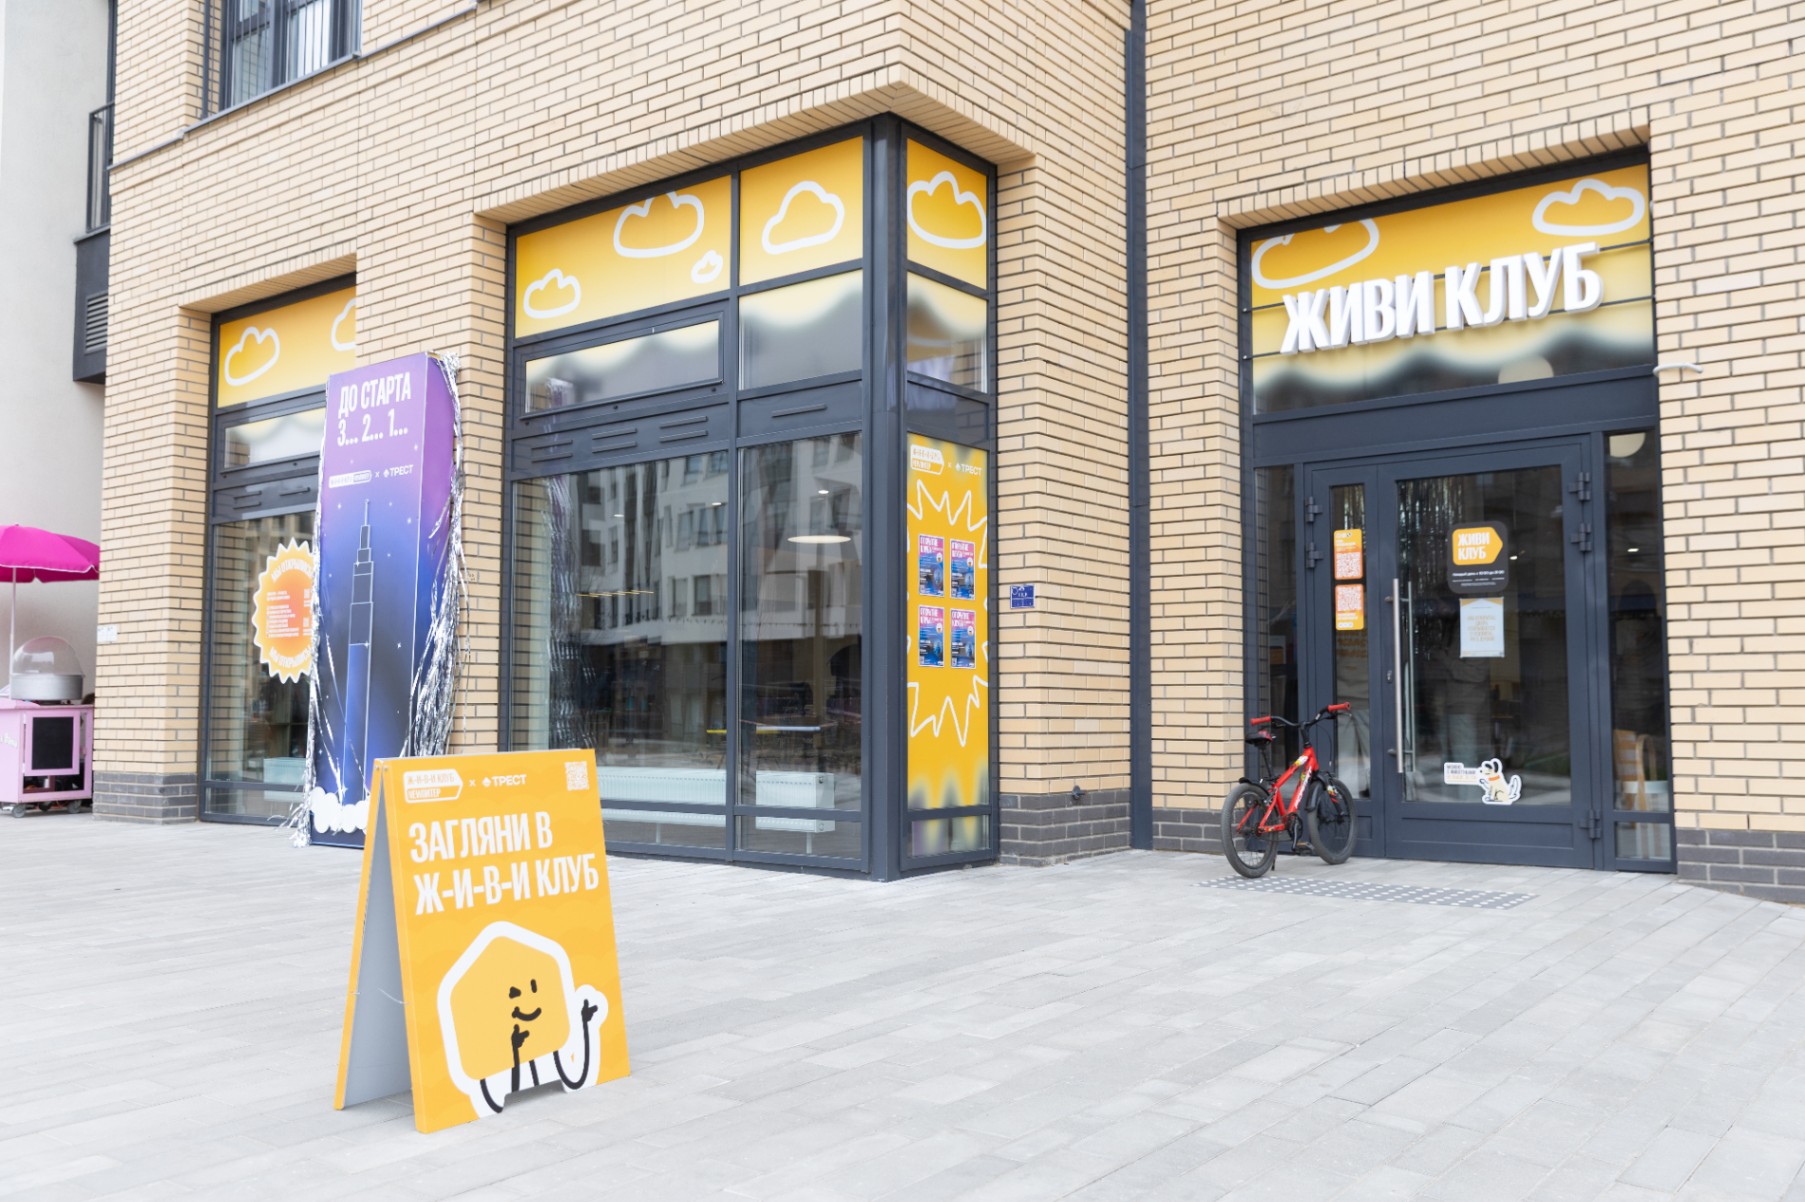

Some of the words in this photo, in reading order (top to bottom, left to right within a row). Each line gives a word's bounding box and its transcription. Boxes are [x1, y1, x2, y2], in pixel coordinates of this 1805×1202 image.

[1280, 271, 1435, 355] ЖИВИ
[1445, 241, 1604, 330] КЛУБ
[338, 384, 358, 419] ДО
[361, 372, 411, 409] СТАРТА
[337, 419, 358, 446] 3...
[362, 413, 383, 442] 2...
[387, 408, 408, 437] 1...
[390, 464, 414, 477] ТРЕСТ
[960, 463, 982, 476] ТРЕСТ
[1457, 532, 1490, 546] ЖИВИ
[1457, 546, 1487, 561] КЛУБ
[437, 772, 455, 783] КЛУБ
[492, 774, 527, 787] ТРЕСТ
[409, 813, 531, 863] ЗАГЛЯНИ
[535, 811, 553, 848] В
[413, 861, 531, 916] Ж-И-В-И
[535, 853, 599, 897] КЛУБ
